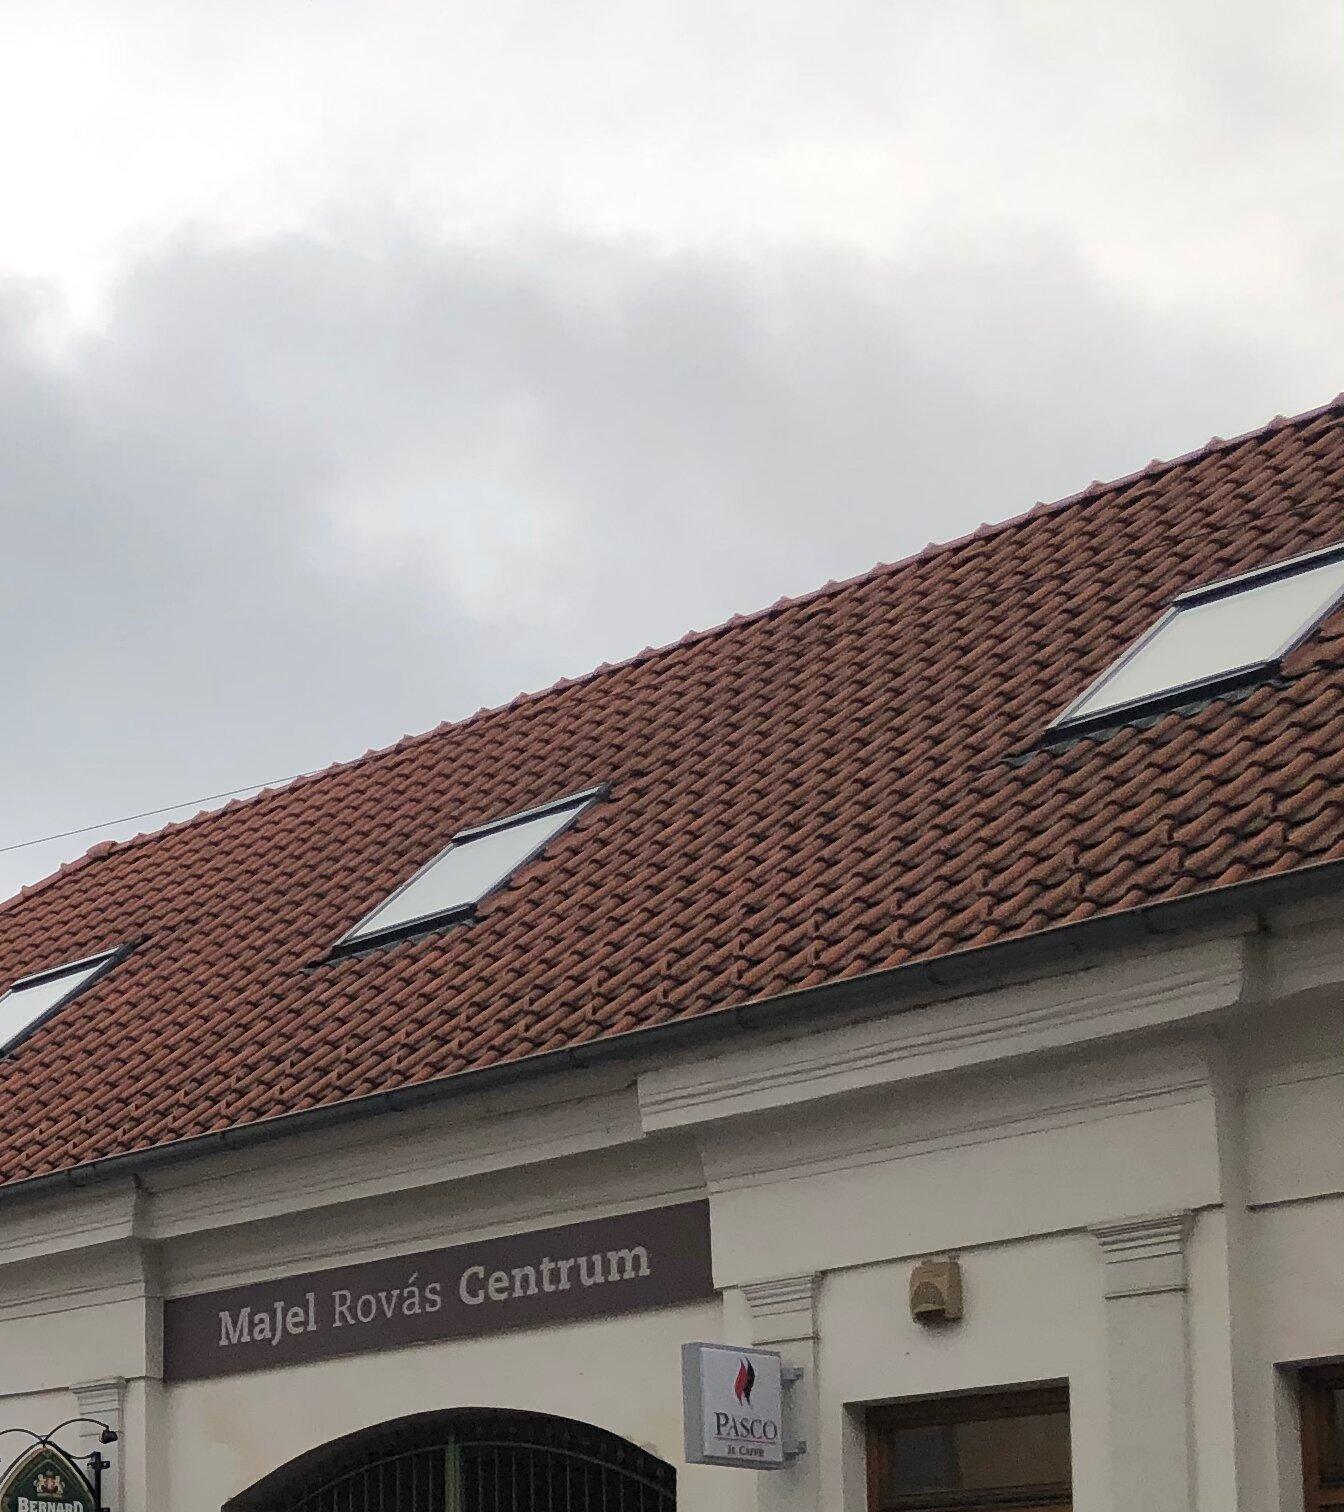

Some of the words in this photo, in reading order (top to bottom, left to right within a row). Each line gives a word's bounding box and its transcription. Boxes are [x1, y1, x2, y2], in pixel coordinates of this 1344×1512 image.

[332, 1272, 442, 1328] Rovás
[459, 1243, 650, 1306] Centrum
[713, 1411, 778, 1441] PASCO
